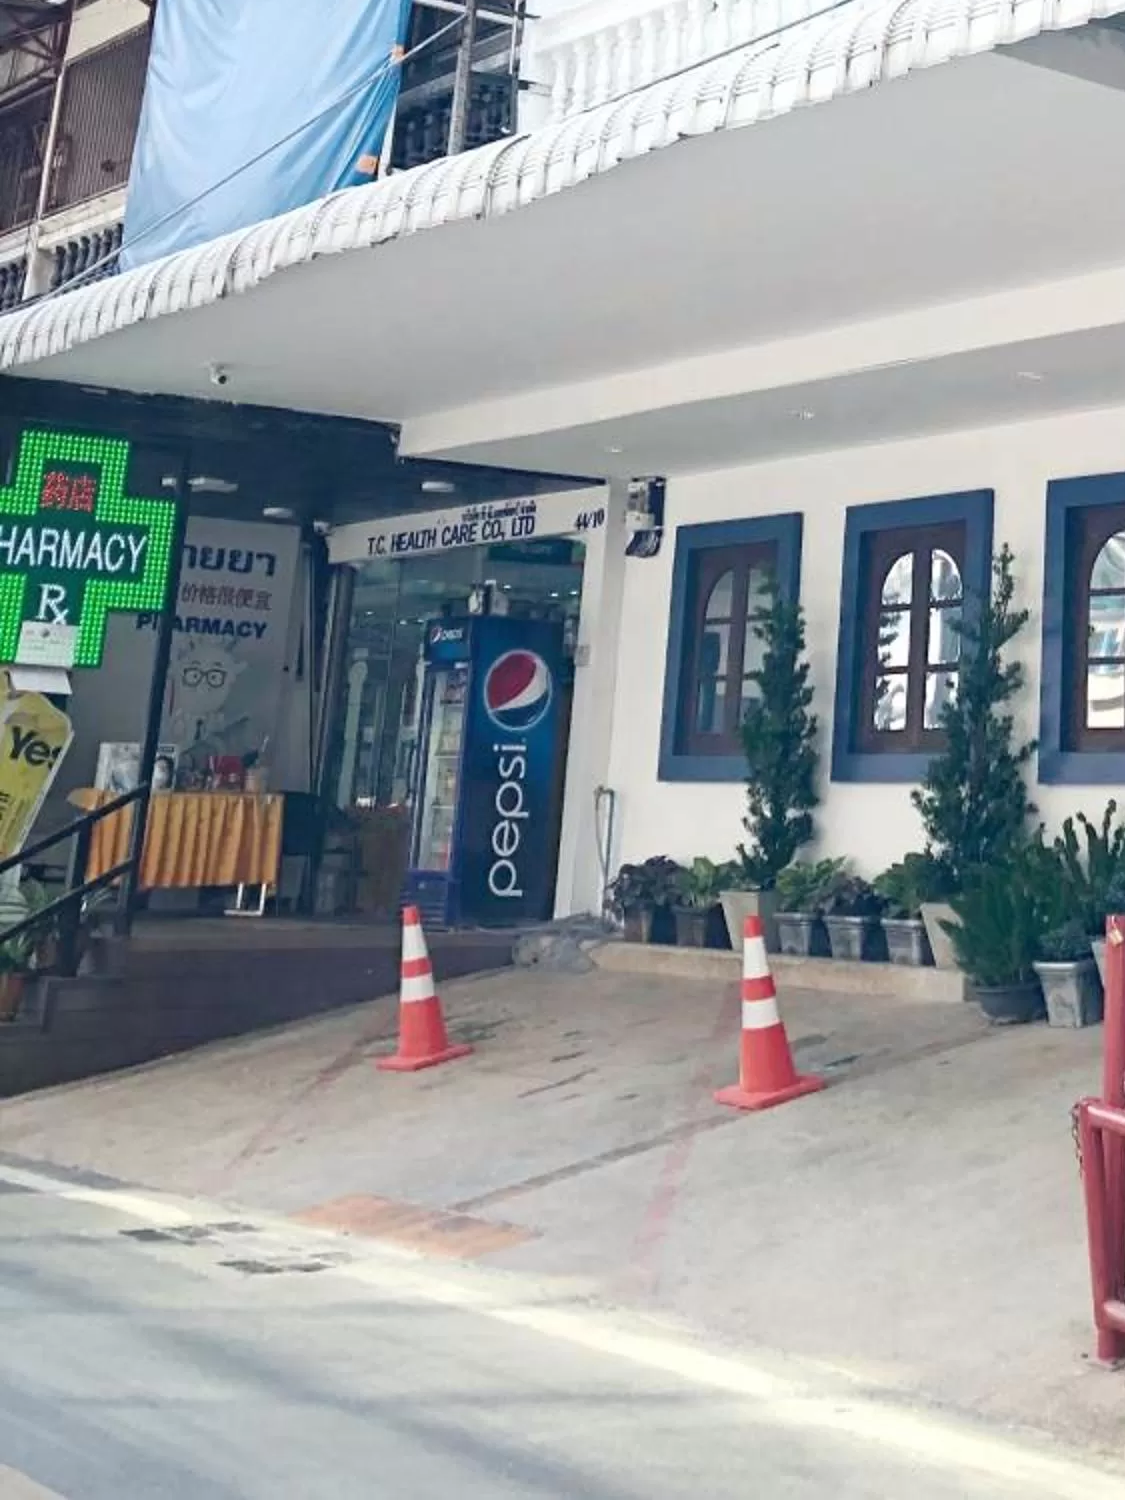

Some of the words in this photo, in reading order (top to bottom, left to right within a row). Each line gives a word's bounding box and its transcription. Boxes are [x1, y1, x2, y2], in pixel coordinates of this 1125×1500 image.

[391, 527, 437, 553] HEALTH
[441, 522, 478, 547] CARE
[511, 515, 535, 537] LTD
[488, 743, 529, 897] pepsi
